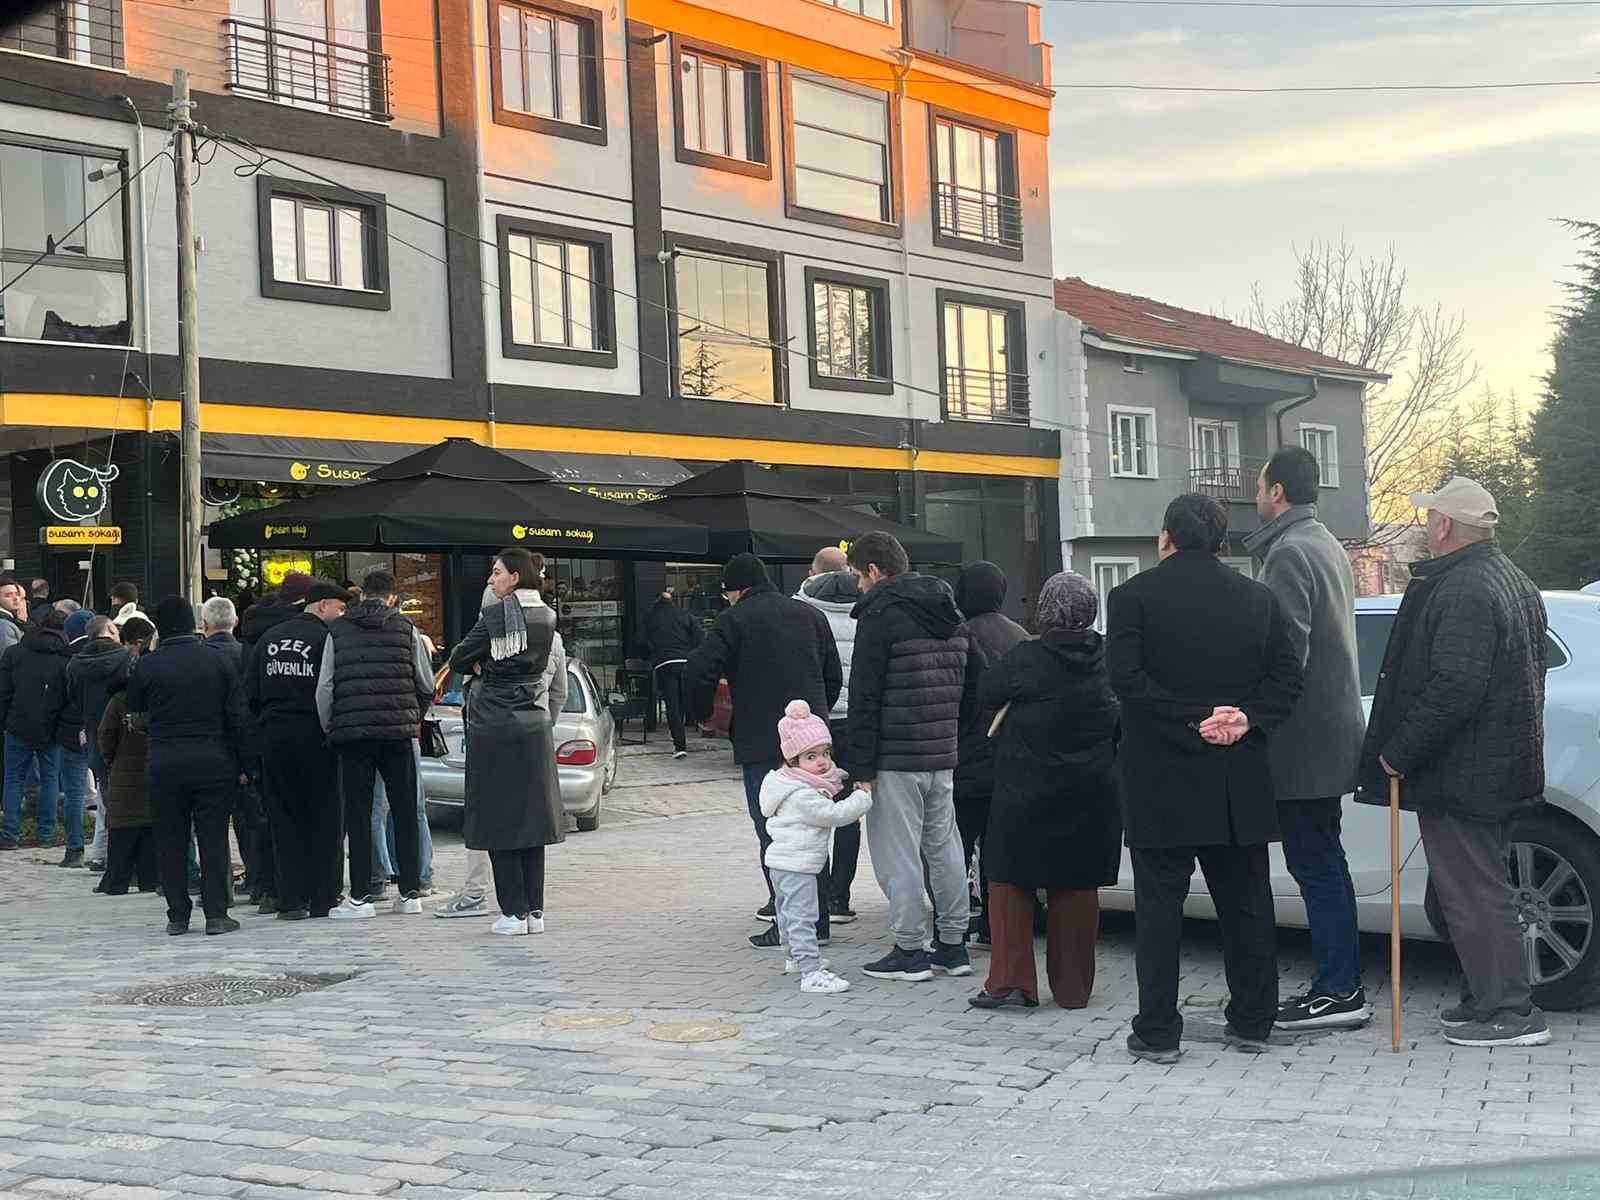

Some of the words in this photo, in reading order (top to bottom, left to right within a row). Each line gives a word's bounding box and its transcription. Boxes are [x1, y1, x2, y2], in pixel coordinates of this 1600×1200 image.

[48, 529, 86, 538] susam
[529, 527, 562, 537] susam
[267, 639, 312, 660] ÖZEL
[266, 658, 315, 677] GÜVENLİK
